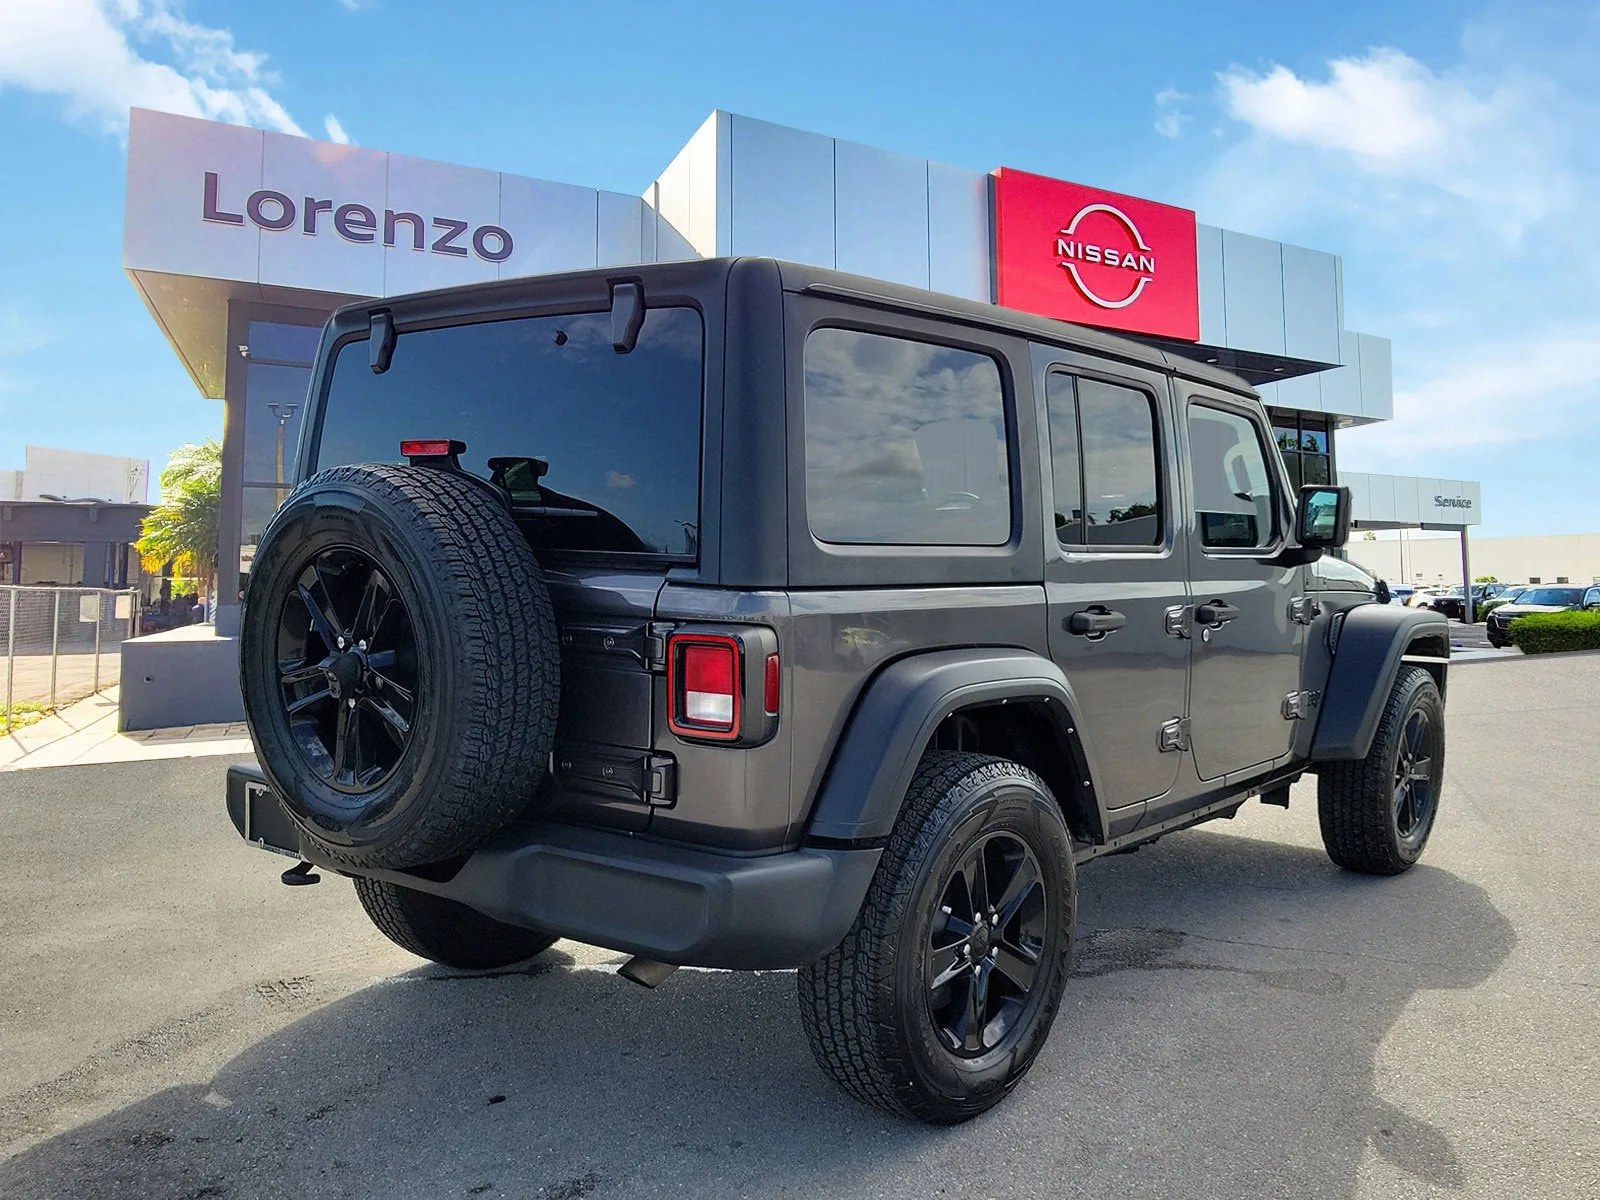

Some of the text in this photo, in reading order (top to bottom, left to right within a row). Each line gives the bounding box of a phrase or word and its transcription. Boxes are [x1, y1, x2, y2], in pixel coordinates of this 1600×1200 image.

[203, 171, 514, 262] Lorenzo
[1057, 238, 1155, 273] NISSAN
[1434, 495, 1472, 509] Service
